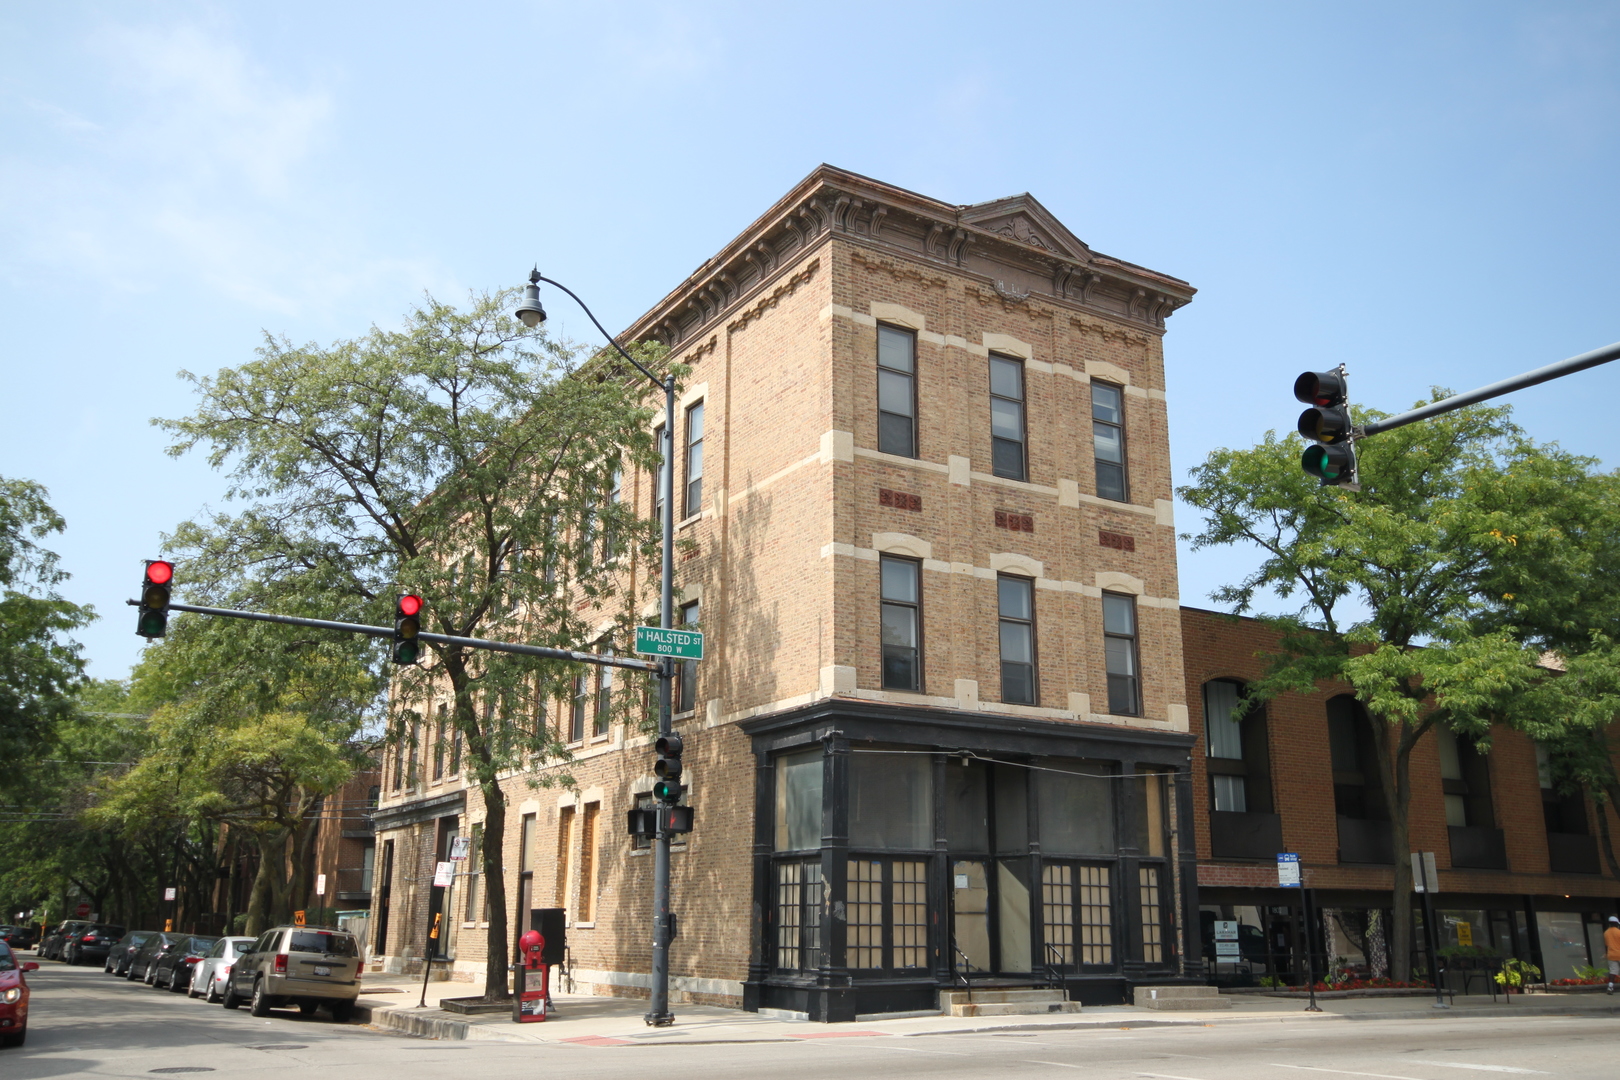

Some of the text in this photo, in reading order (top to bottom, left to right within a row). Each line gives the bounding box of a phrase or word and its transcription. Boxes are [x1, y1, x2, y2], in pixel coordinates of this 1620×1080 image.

[638, 630, 701, 645] N HALSTED ST
[657, 644, 672, 653] 800
